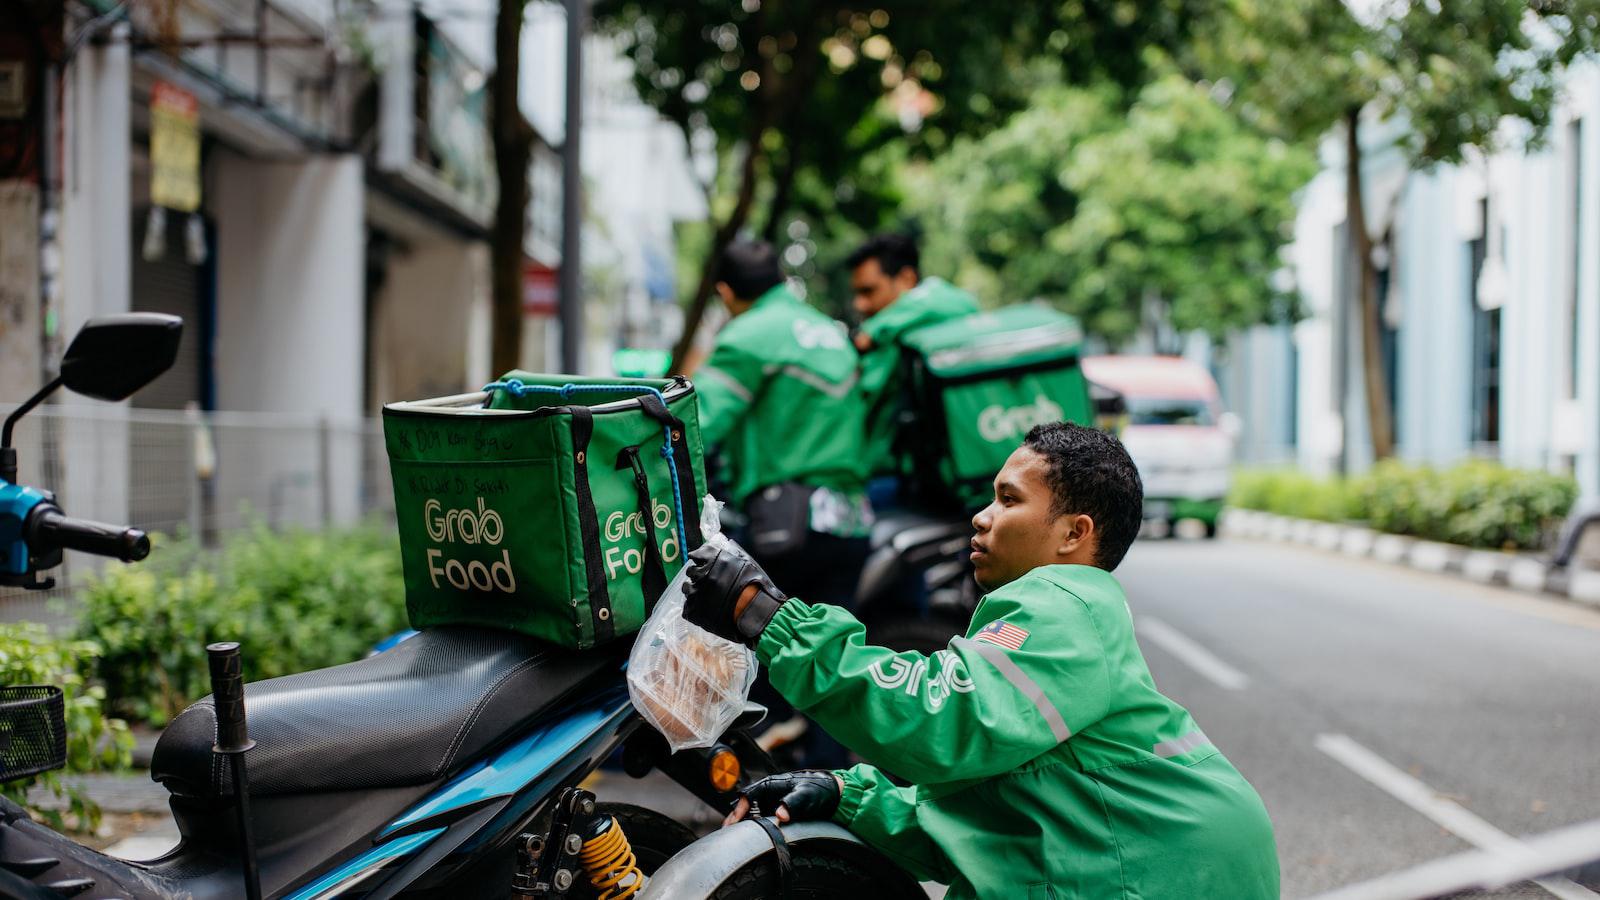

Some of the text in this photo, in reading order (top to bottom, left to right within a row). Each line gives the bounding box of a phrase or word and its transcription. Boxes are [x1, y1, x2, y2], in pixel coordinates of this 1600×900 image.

[424, 497, 505, 546] Grab
[426, 548, 517, 594] Food
[605, 527, 680, 580] Fod
